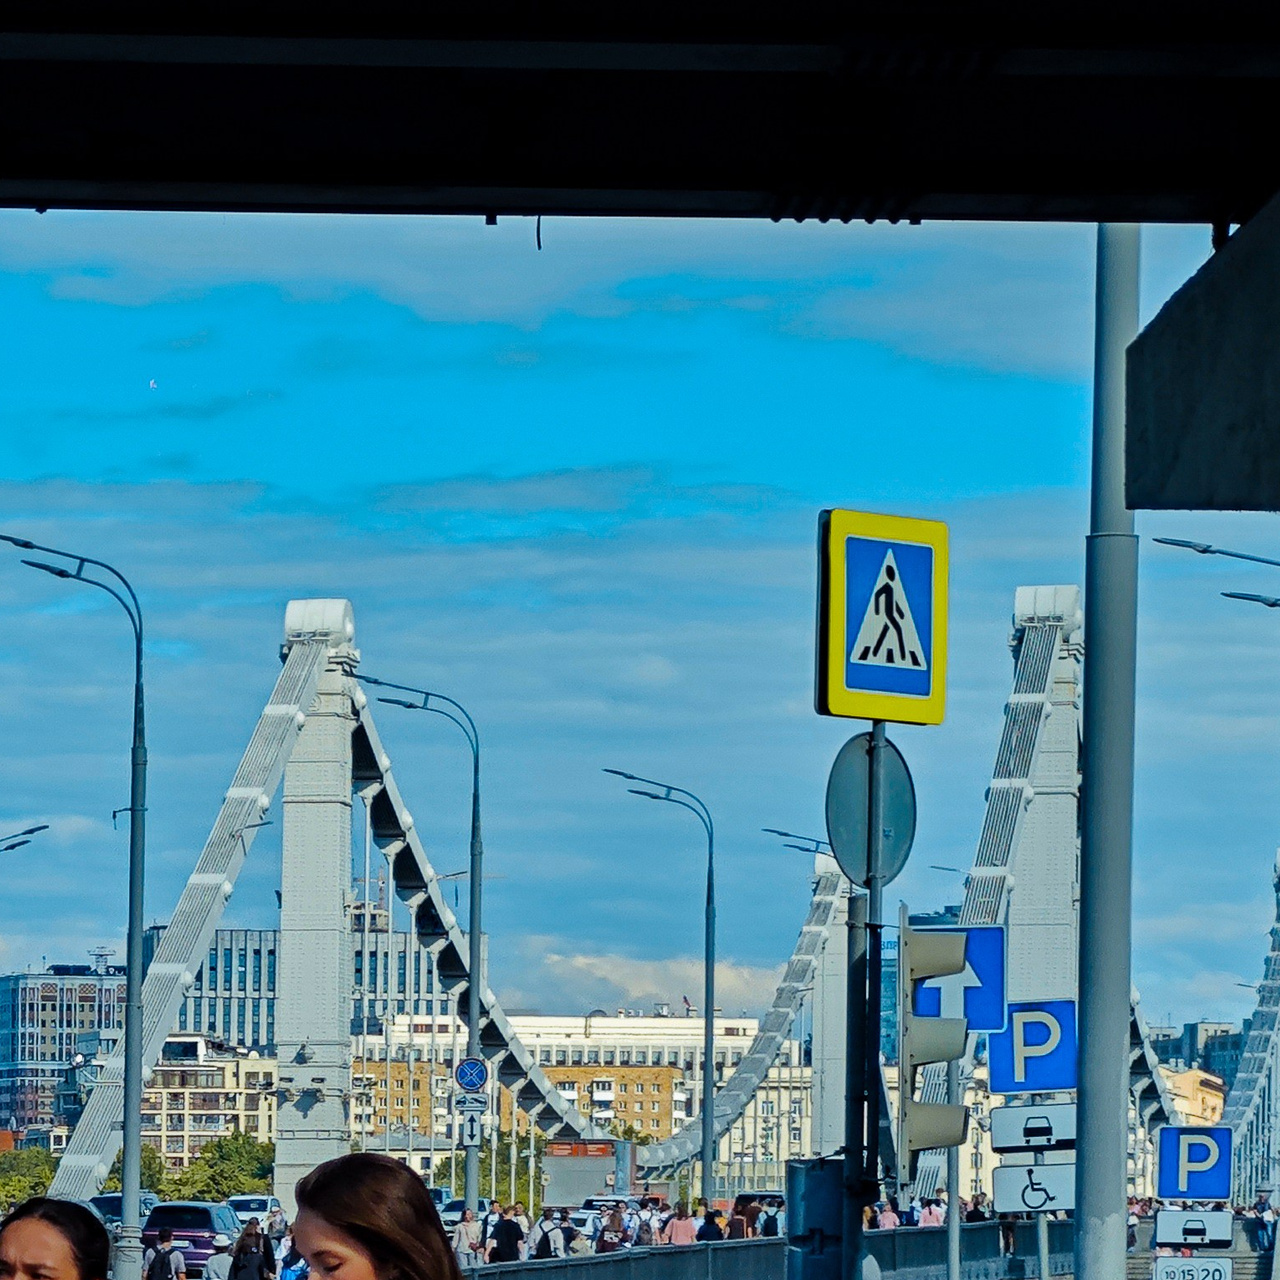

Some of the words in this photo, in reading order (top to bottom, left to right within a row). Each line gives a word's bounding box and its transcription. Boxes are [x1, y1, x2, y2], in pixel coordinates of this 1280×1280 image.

[1013, 1011, 1061, 1082] P
[1179, 1134, 1219, 1192] P
[1165, 1270, 1176, 1280] 10
